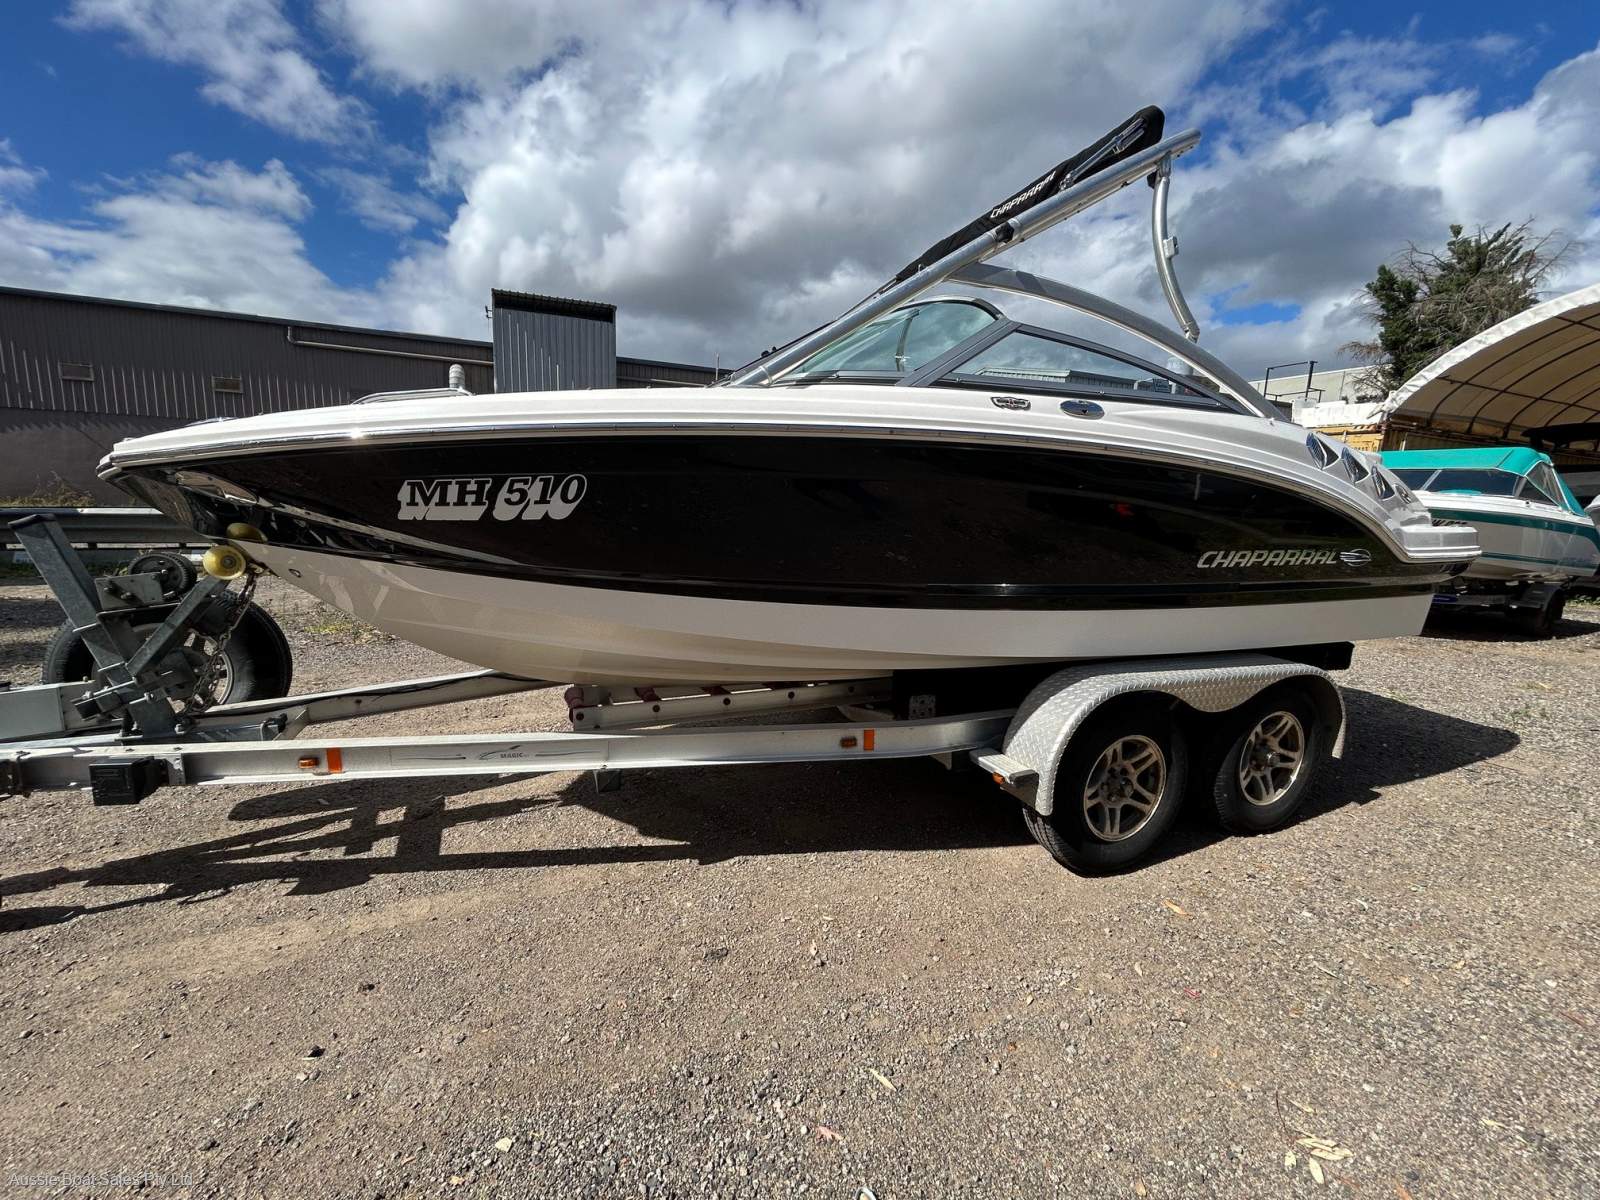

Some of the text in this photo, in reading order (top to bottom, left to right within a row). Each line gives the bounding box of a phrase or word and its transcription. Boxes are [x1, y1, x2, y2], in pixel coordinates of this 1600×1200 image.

[397, 474, 588, 521] MH 510
[1197, 549, 1337, 568] CHAPARRAL
